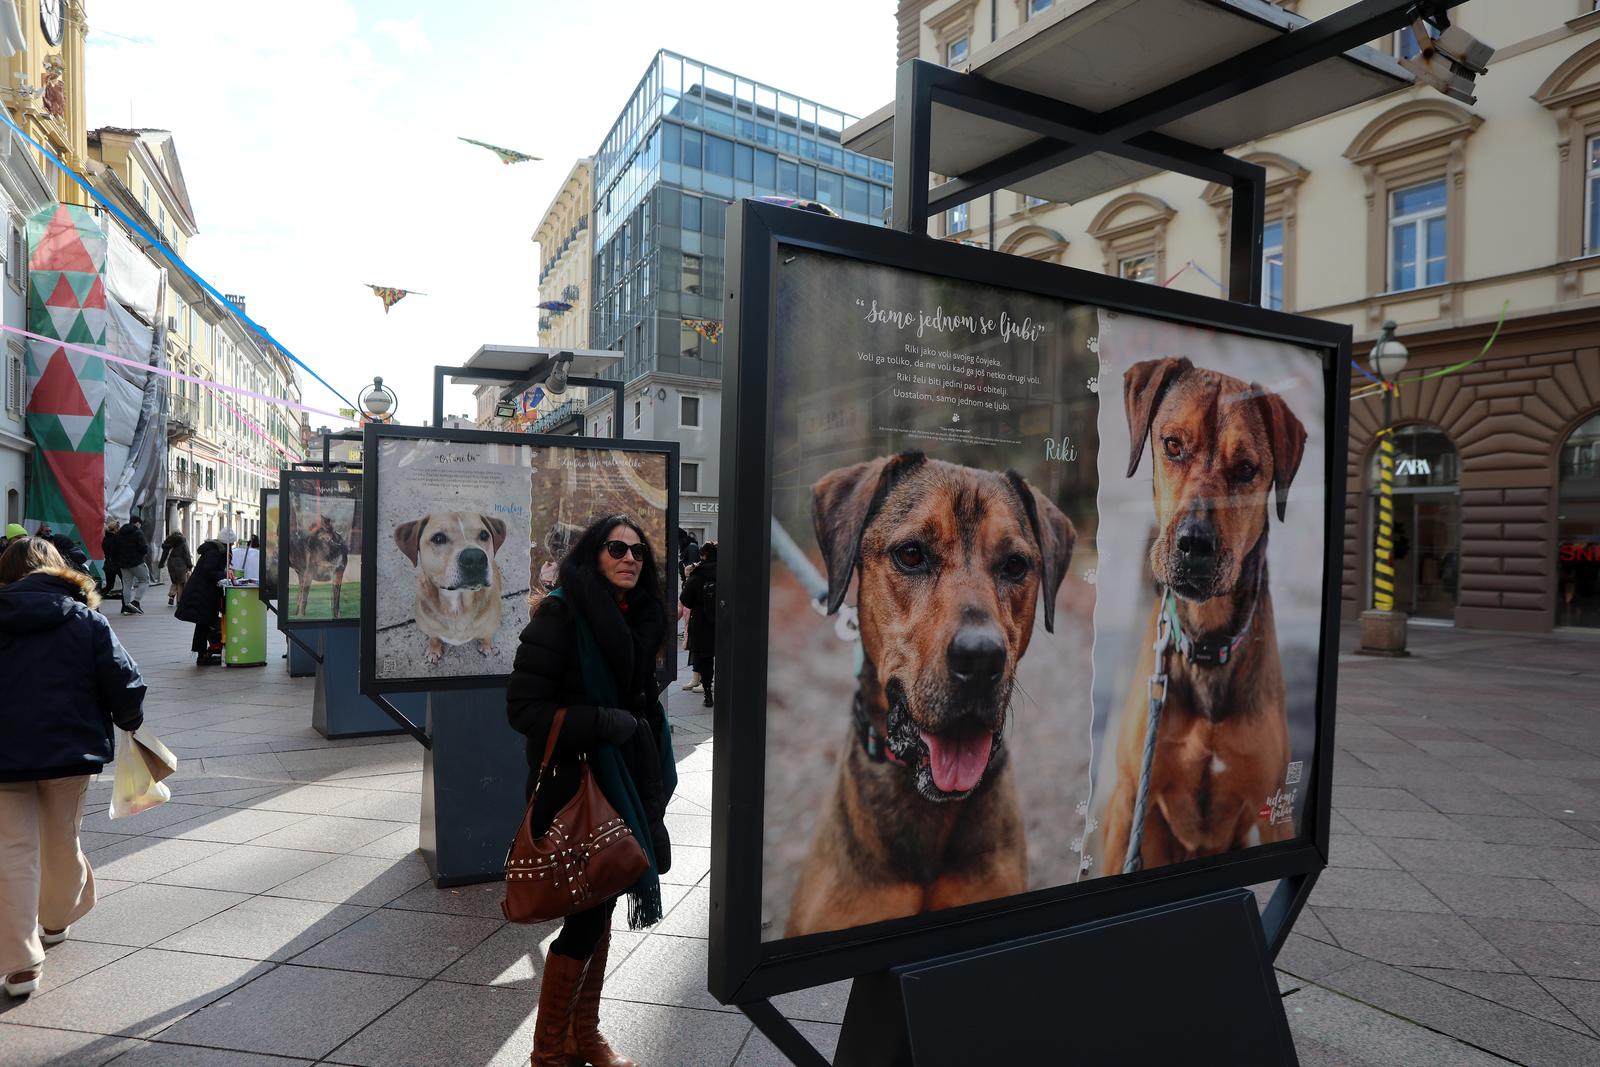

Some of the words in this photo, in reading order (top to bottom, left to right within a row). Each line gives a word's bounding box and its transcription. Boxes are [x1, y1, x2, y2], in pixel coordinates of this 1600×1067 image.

[917, 305, 978, 338] jednom
[980, 315, 996, 335] se
[857, 351, 874, 361] Voli
[876, 356, 885, 365] ga
[887, 356, 912, 367] toliko,
[914, 359, 924, 368] da
[926, 361, 935, 369] ne
[938, 363, 951, 371] voli
[953, 365, 965, 374] kad
[967, 368, 974, 377] ga
[975, 368, 985, 378] još
[987, 370, 1006, 380] netko
[1008, 373, 1026, 385] drugi
[1027, 376, 1041, 384] voli.
[905, 344, 919, 354] Riki
[920, 346, 936, 357] jako
[938, 349, 951, 358] voli
[953, 353, 974, 365] svojeg
[976, 355, 1002, 368] čovjeka.
[897, 372, 911, 382] Riki
[913, 375, 926, 384] želi
[929, 377, 941, 386] biti
[942, 378, 963, 389] jedini
[964, 383, 976, 392] pas
[983, 385, 1008, 398] obitelji.
[893, 389, 934, 403] Uostalom,
[936, 395, 957, 404] samo
[957, 396, 984, 409] jednom
[985, 401, 993, 410] se
[994, 400, 1010, 412] ljubi.
[1044, 436, 1077, 462] Riki
[1395, 458, 1432, 476] ZARA
